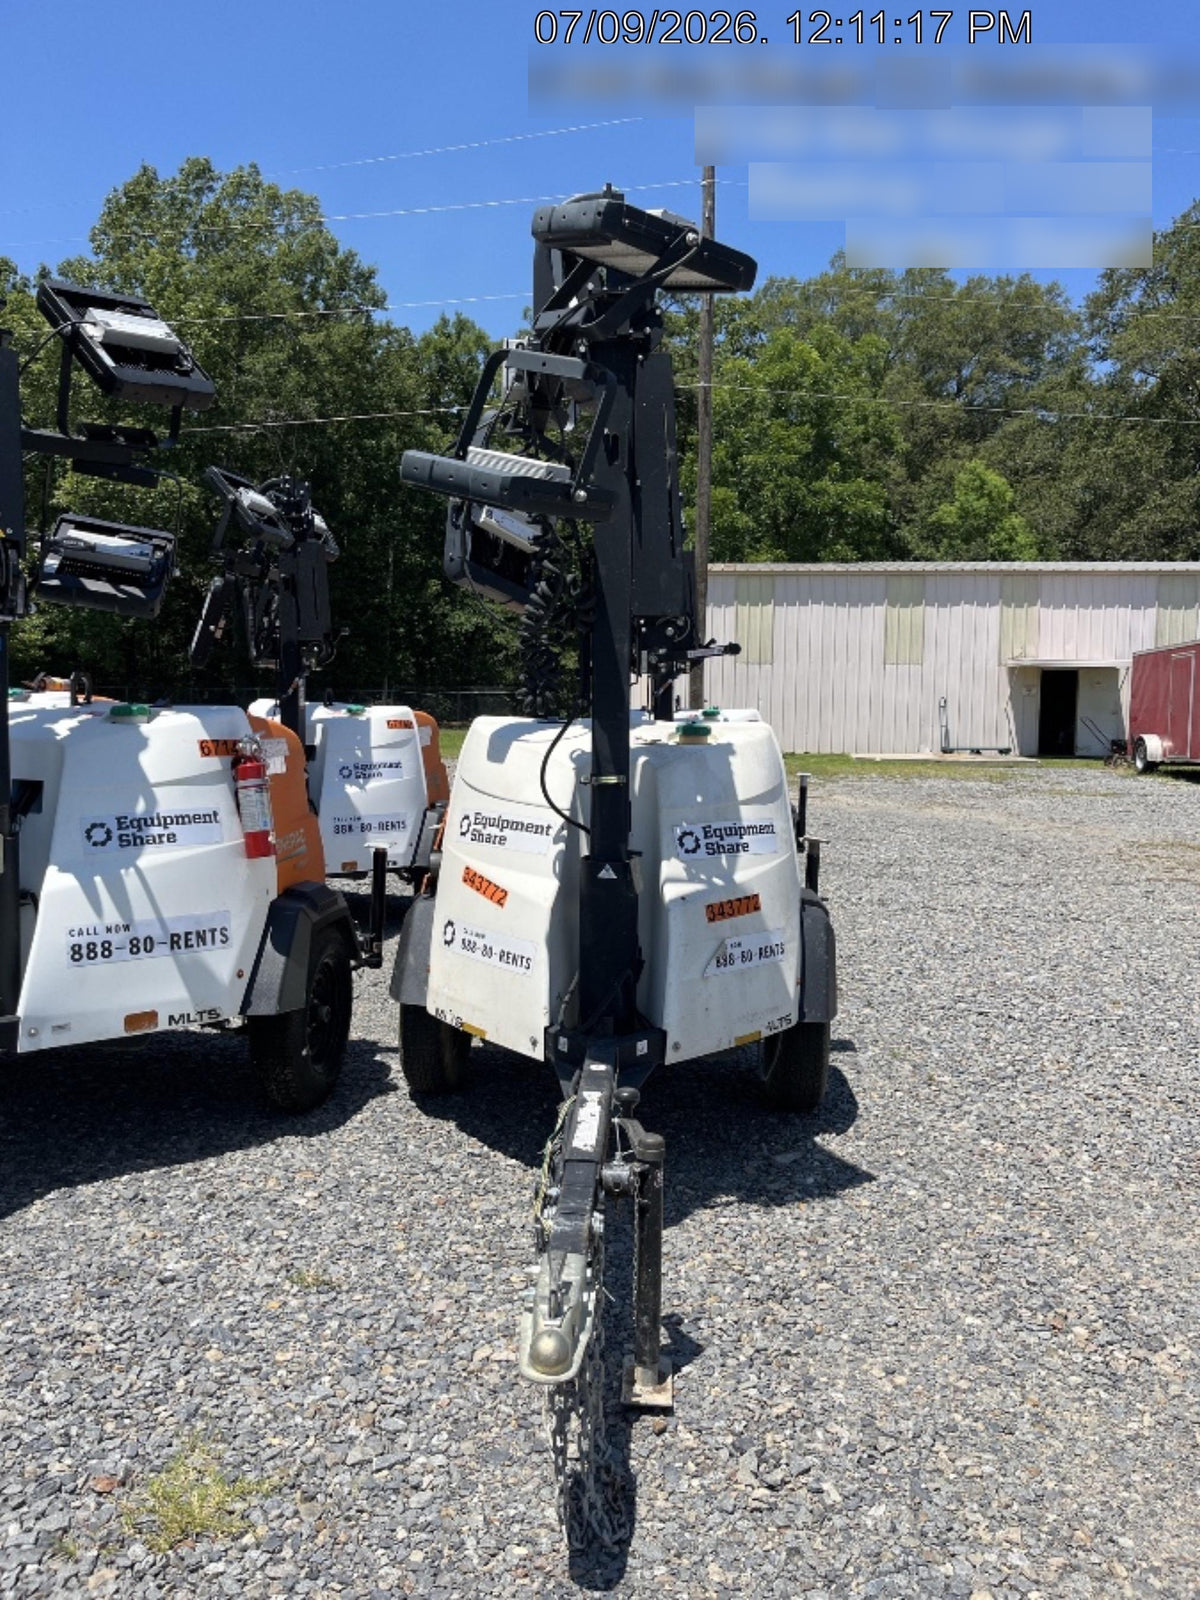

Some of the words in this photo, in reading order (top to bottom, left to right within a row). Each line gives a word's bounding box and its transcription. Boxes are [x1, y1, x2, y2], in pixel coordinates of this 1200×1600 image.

[115, 810, 220, 832] Equipment
[472, 812, 553, 836] Equipment
[117, 832, 177, 848] Share
[470, 828, 507, 845] Share
[702, 823, 775, 842] Equipment
[705, 842, 749, 856] Share
[462, 865, 508, 909] 343772
[706, 894, 760, 922] 343772
[68, 926, 99, 937] CALL
[105, 924, 131, 934] NOW
[70, 927, 229, 962] 888-80-RENTS
[168, 1008, 221, 1026] MLTS
